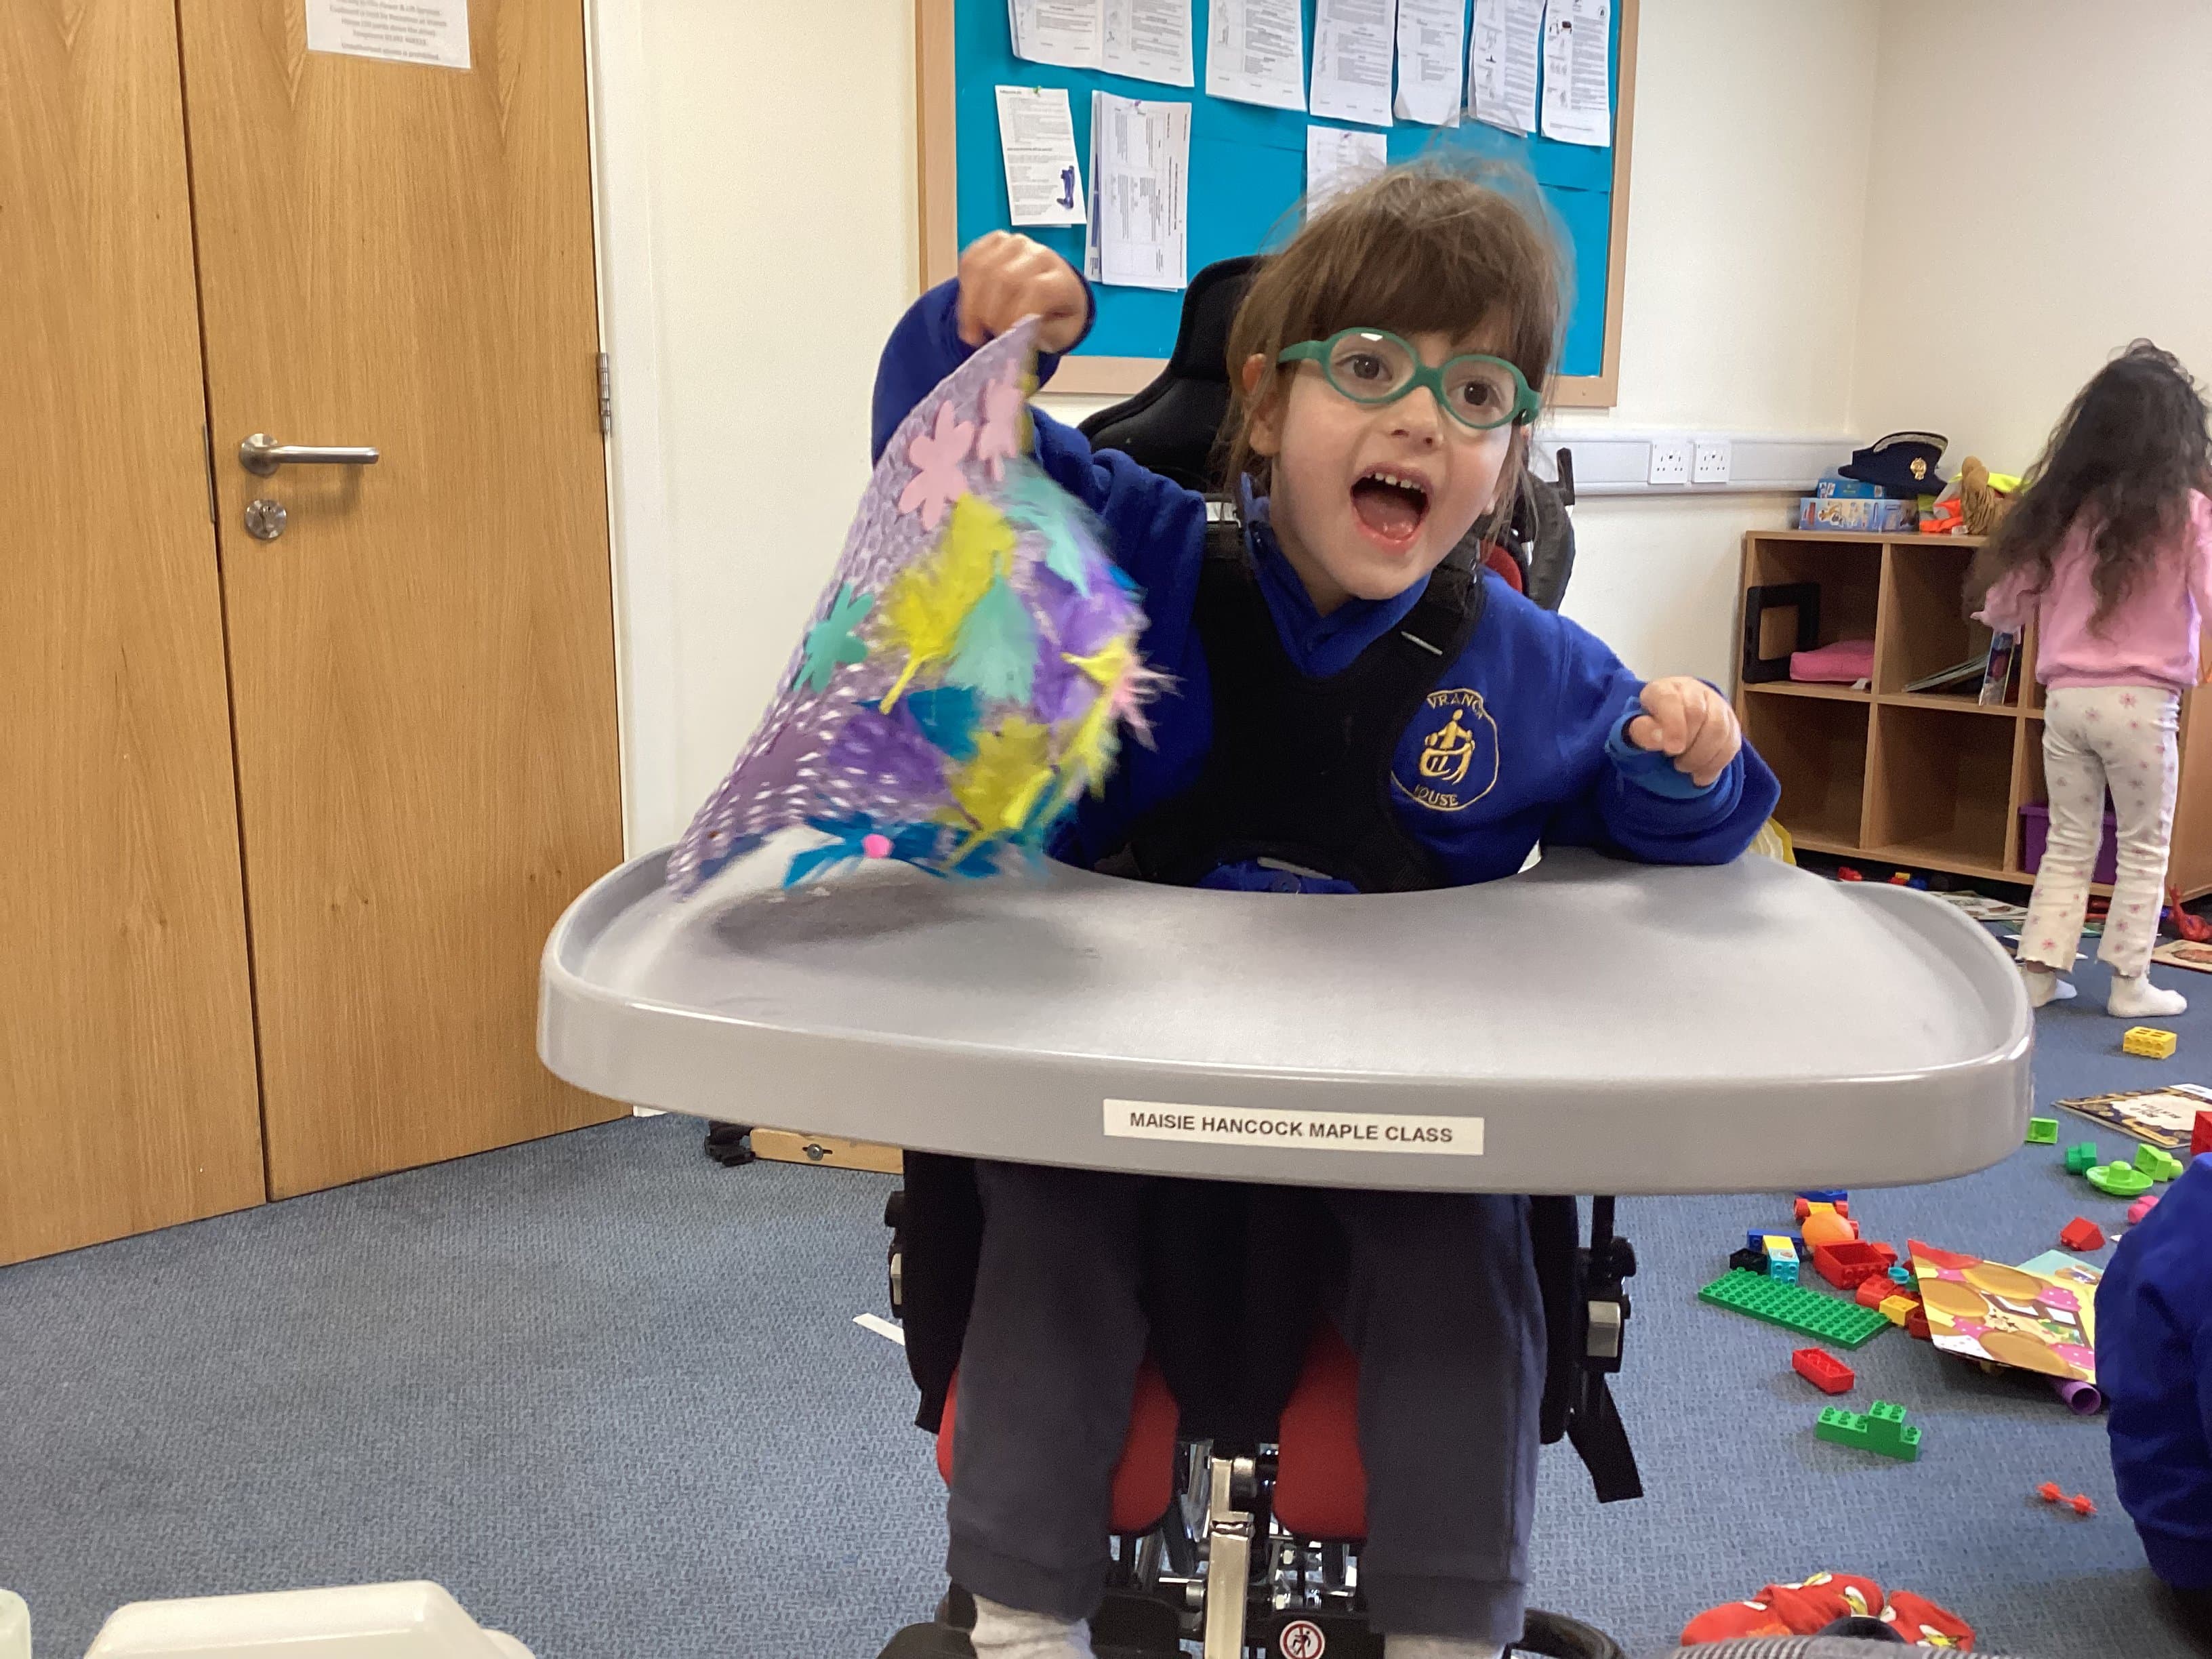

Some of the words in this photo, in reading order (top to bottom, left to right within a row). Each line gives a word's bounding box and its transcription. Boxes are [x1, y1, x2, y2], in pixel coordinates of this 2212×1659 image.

[1130, 1112, 1195, 1130] MAISIE
[1202, 1117, 1303, 1136] HANCOCK
[1309, 1123, 1378, 1140] MAPLE
[1385, 1126, 1452, 1143] CLASS
